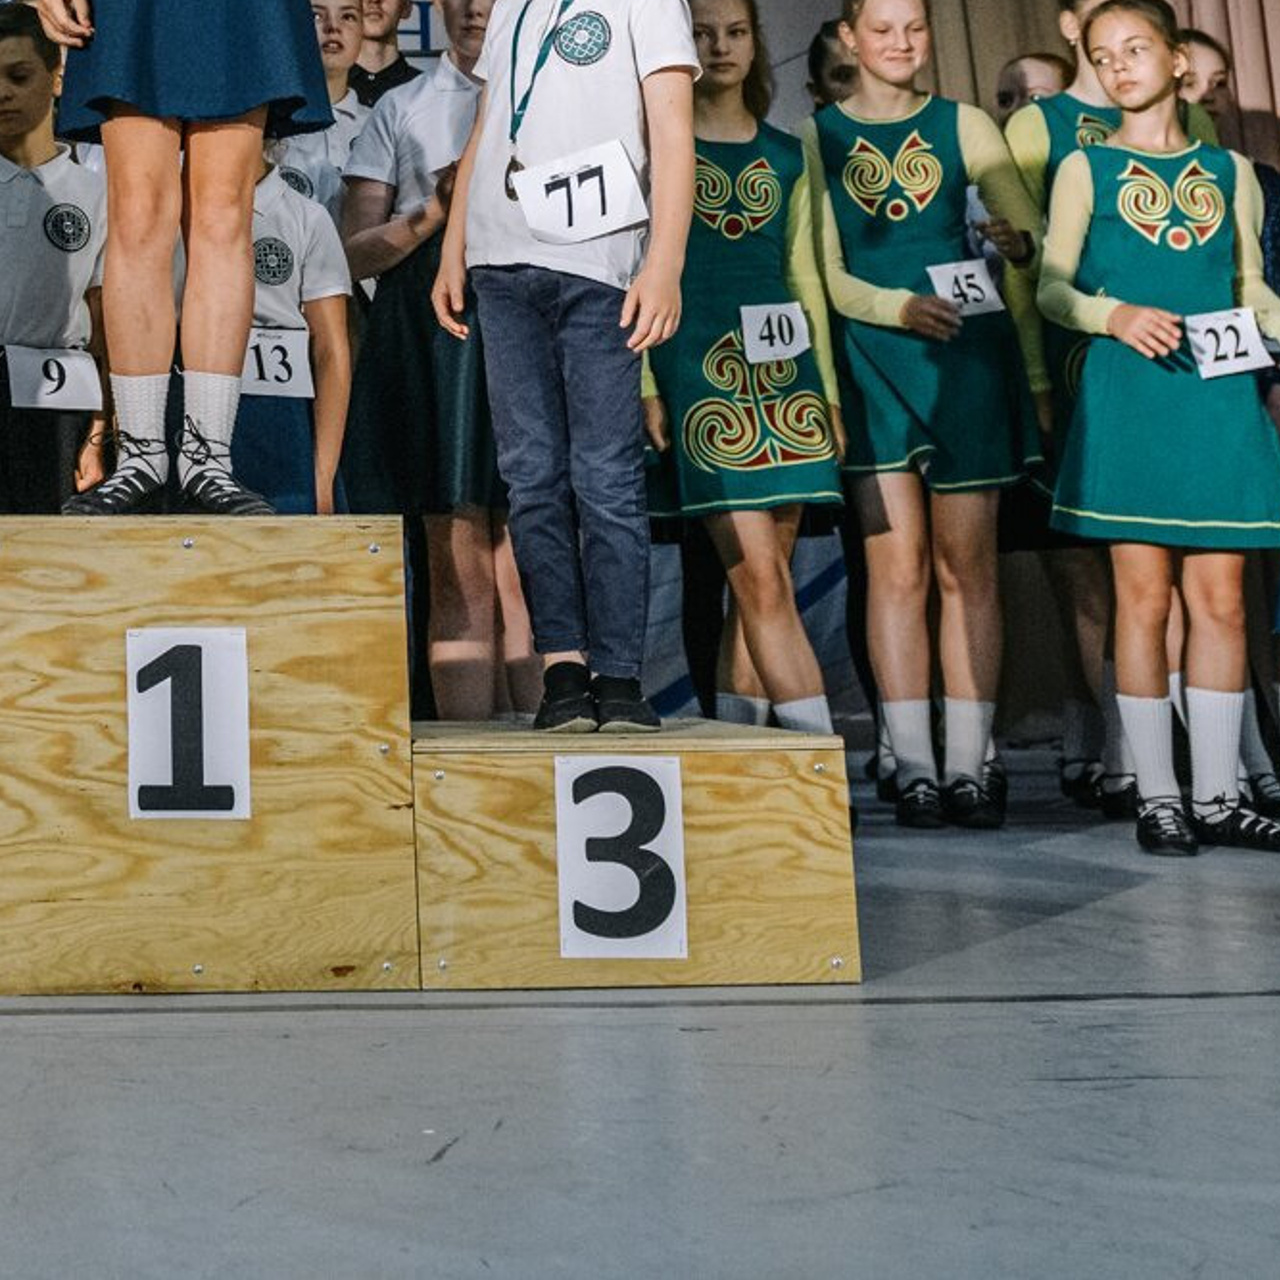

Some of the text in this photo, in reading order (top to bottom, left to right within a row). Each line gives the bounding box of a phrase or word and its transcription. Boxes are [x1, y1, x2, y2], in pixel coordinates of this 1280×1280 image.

[543, 164, 607, 228] 77
[952, 273, 986, 304] 45
[758, 313, 796, 348] 40
[1204, 324, 1250, 363] 22
[41, 358, 66, 396] 9
[249, 343, 293, 384] 13
[136, 644, 235, 812] 1
[571, 765, 677, 939] 3
